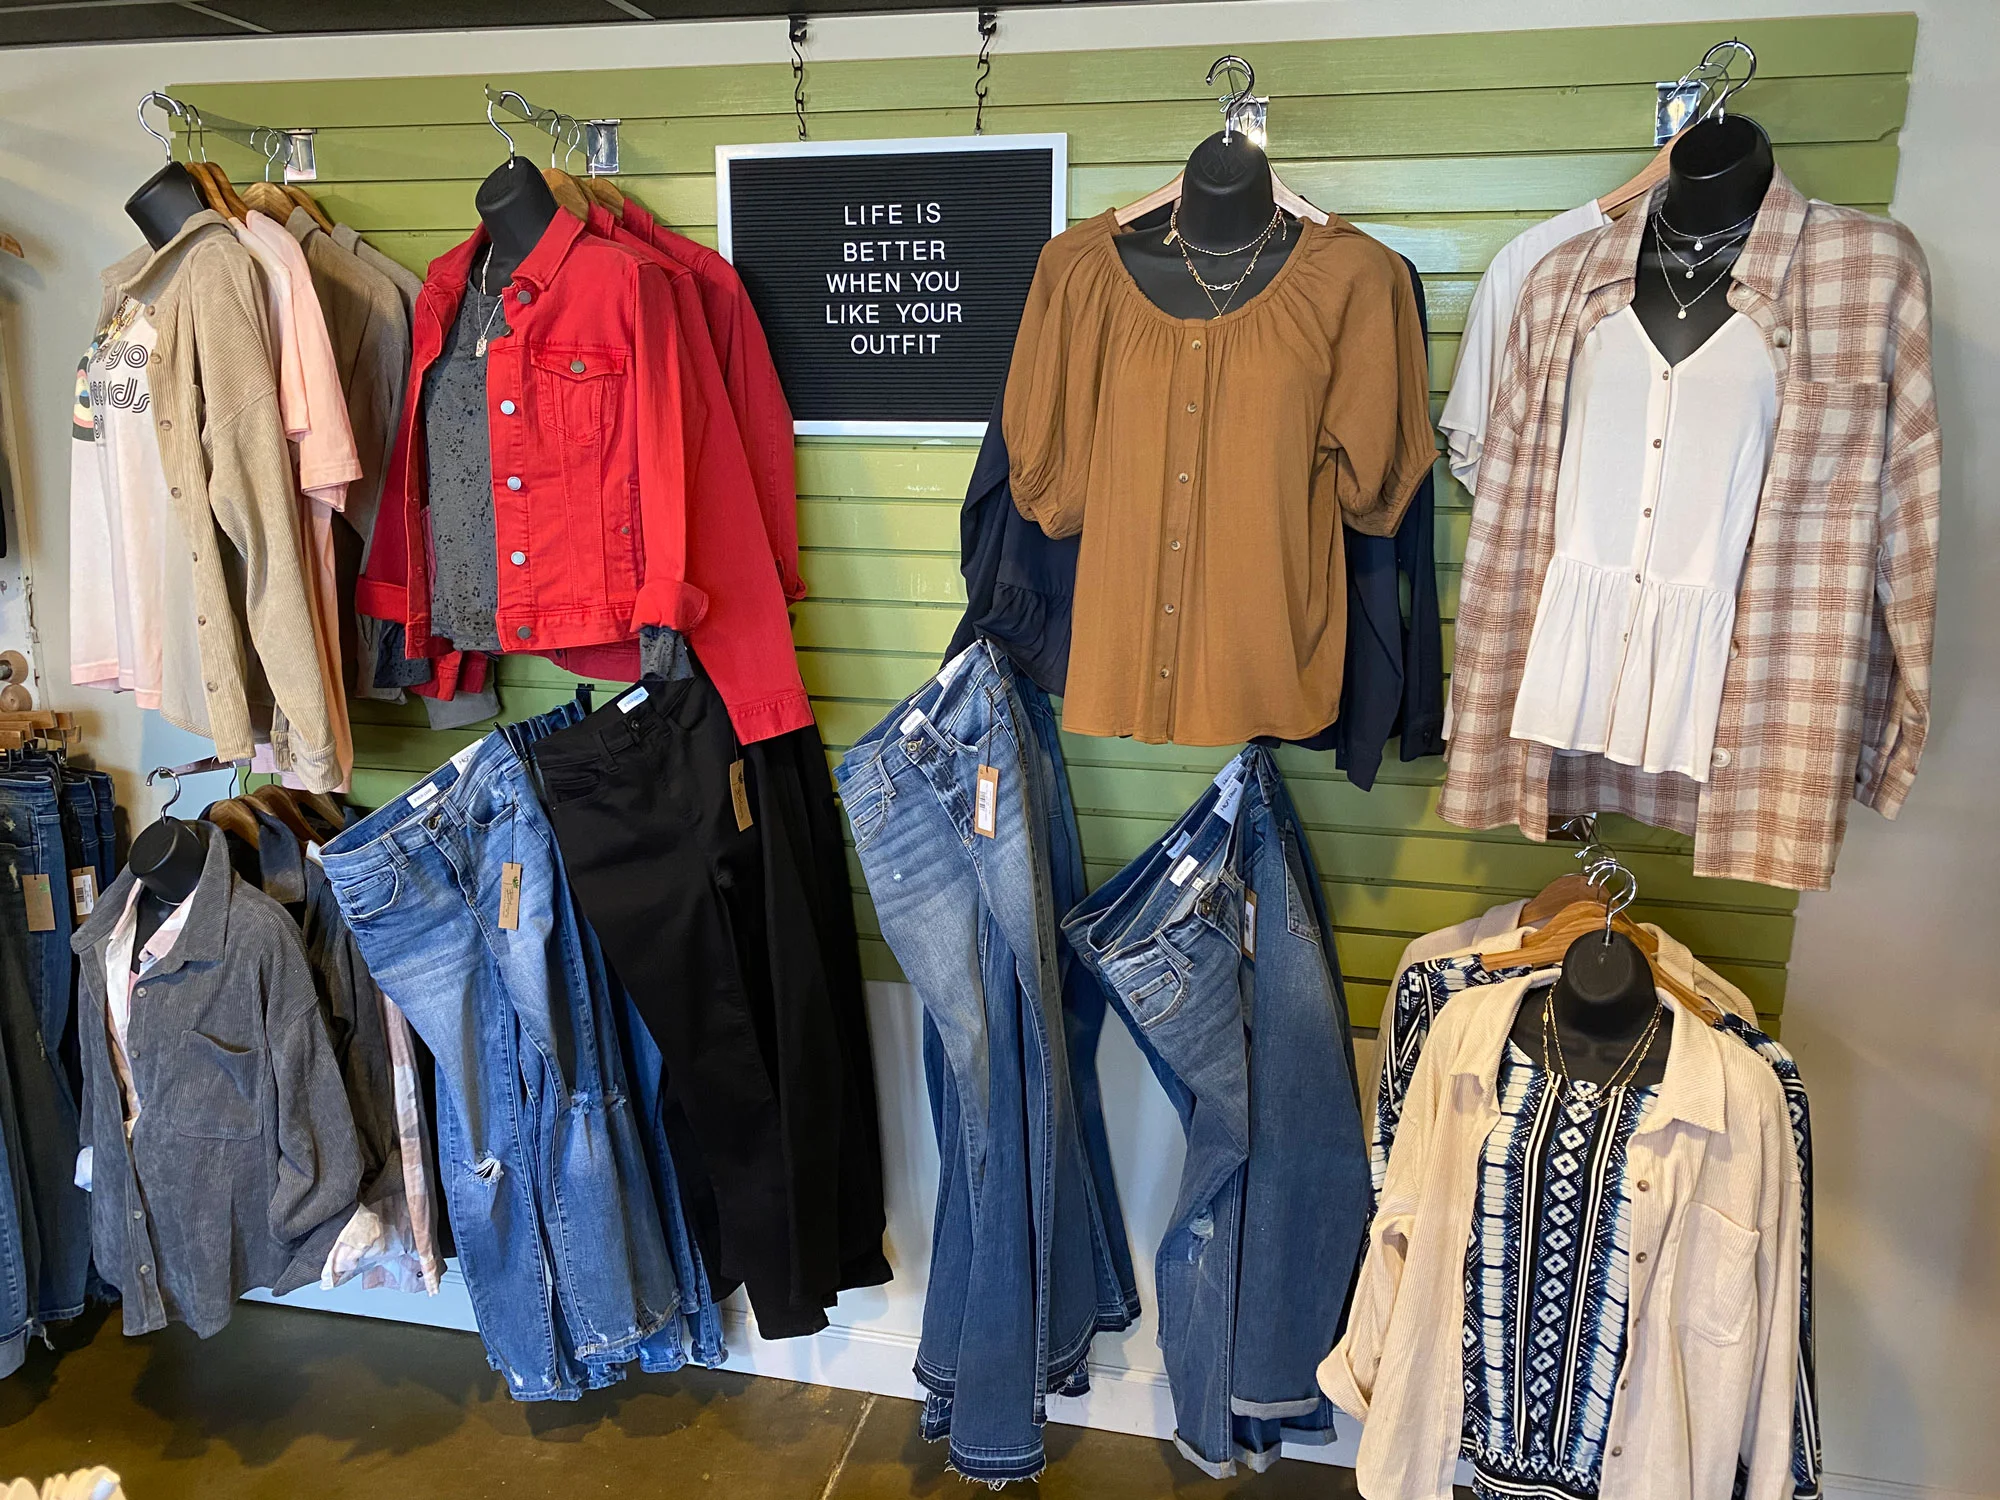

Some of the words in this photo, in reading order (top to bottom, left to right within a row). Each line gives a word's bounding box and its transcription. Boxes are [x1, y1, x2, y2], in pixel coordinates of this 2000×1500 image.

[844, 204, 903, 225] LIFE
[917, 203, 941, 224] IS
[843, 240, 946, 262] BETTER
[826, 272, 900, 293] WHEN
[910, 271, 960, 292] YOU
[826, 304, 879, 324] LIKE
[895, 302, 963, 323] YOUR
[850, 334, 941, 355] OUTFIT
